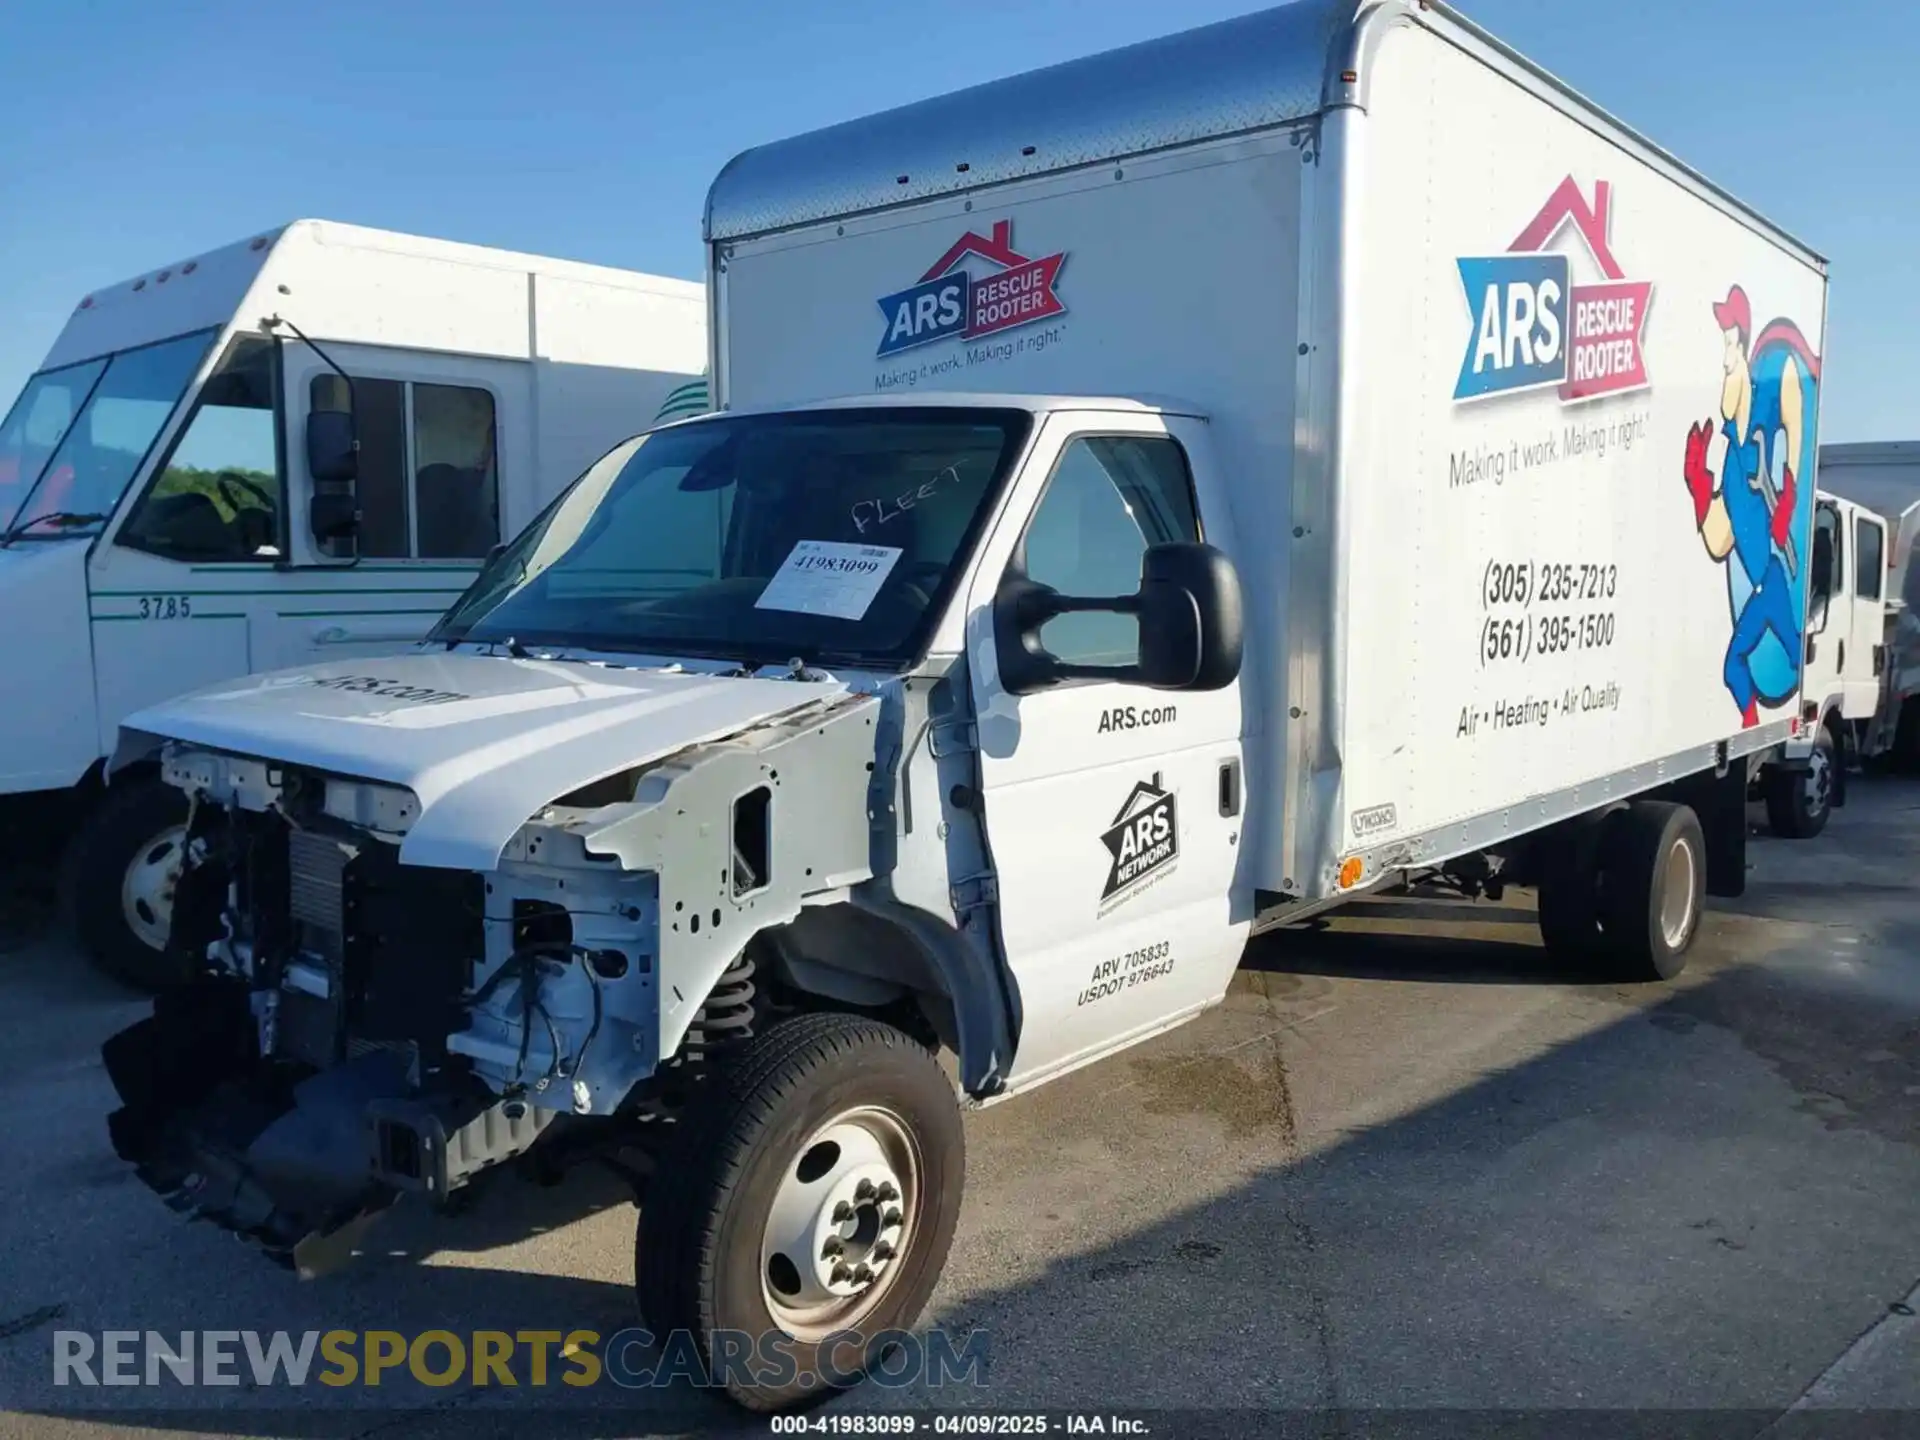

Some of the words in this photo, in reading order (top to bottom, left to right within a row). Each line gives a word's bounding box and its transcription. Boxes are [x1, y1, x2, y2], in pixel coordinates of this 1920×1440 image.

[976, 268, 1044, 305] RESCUE
[976, 291, 1044, 327] ROOTER
[890, 285, 961, 342] ARS
[1473, 278, 1561, 374] ARS
[1576, 297, 1635, 338] RESCUE
[875, 368, 917, 391] Making
[920, 363, 927, 377] it
[930, 354, 963, 376] work.
[966, 342, 1012, 368] Making
[1016, 336, 1024, 352] it
[1027, 327, 1061, 351] right.
[1574, 338, 1635, 381] ROOTER
[1450, 441, 1505, 489] Making
[1509, 439, 1518, 473] it
[1522, 431, 1560, 468] work.
[1563, 424, 1606, 459] Making
[1609, 416, 1616, 446] it
[850, 458, 969, 533] FLEET
[794, 556, 879, 575] 41983099
[1482, 558, 1534, 611] (305)
[1539, 563, 1617, 601] 235-7213
[139, 596, 191, 620] 3785
[1481, 613, 1532, 668] (561)
[1537, 612, 1615, 654] 395-1500
[1098, 704, 1177, 734] ARS.com
[1456, 704, 1480, 738] Air
[1493, 696, 1550, 730] Heating
[1561, 686, 1578, 717] Air
[1581, 680, 1621, 712] Quality
[1118, 804, 1171, 866] ARS
[1117, 838, 1172, 885] NETWORK
[1077, 976, 1126, 1007] USDOT
[1128, 958, 1174, 987] 976643
[1091, 957, 1121, 983] ARV
[1125, 940, 1169, 970] 705833
